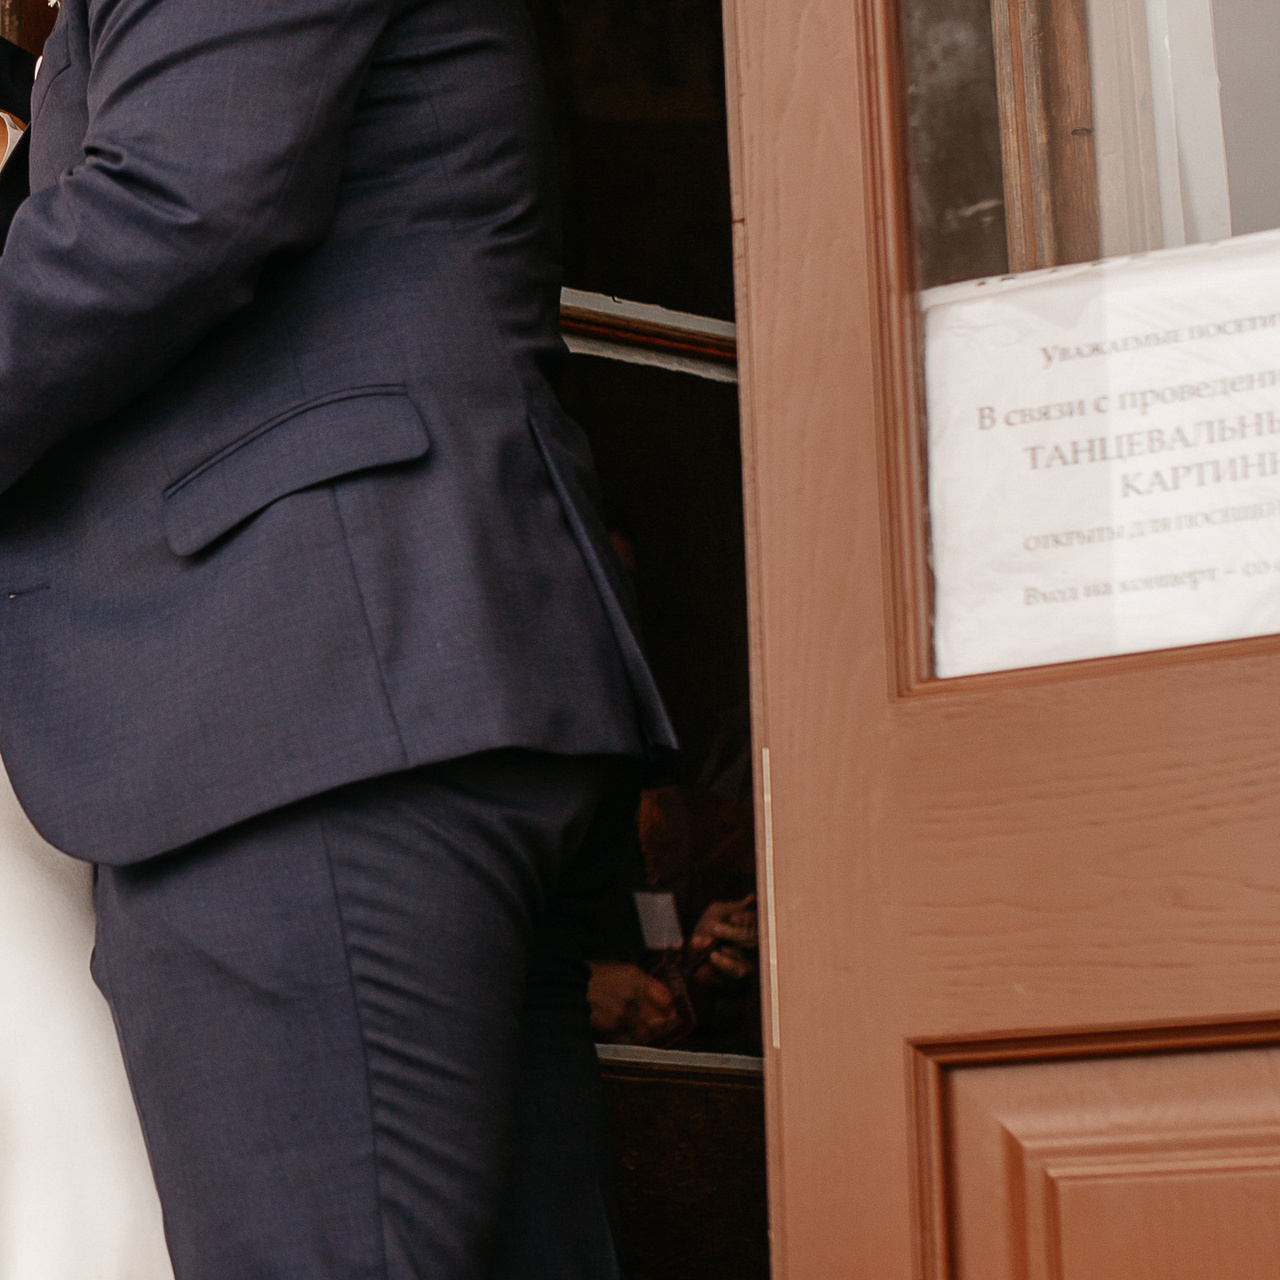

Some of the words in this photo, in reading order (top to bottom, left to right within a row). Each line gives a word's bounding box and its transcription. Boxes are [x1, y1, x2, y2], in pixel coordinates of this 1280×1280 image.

[977, 406, 997, 431] В
[1004, 399, 1086, 427] связи
[1093, 394, 1111, 415] с
